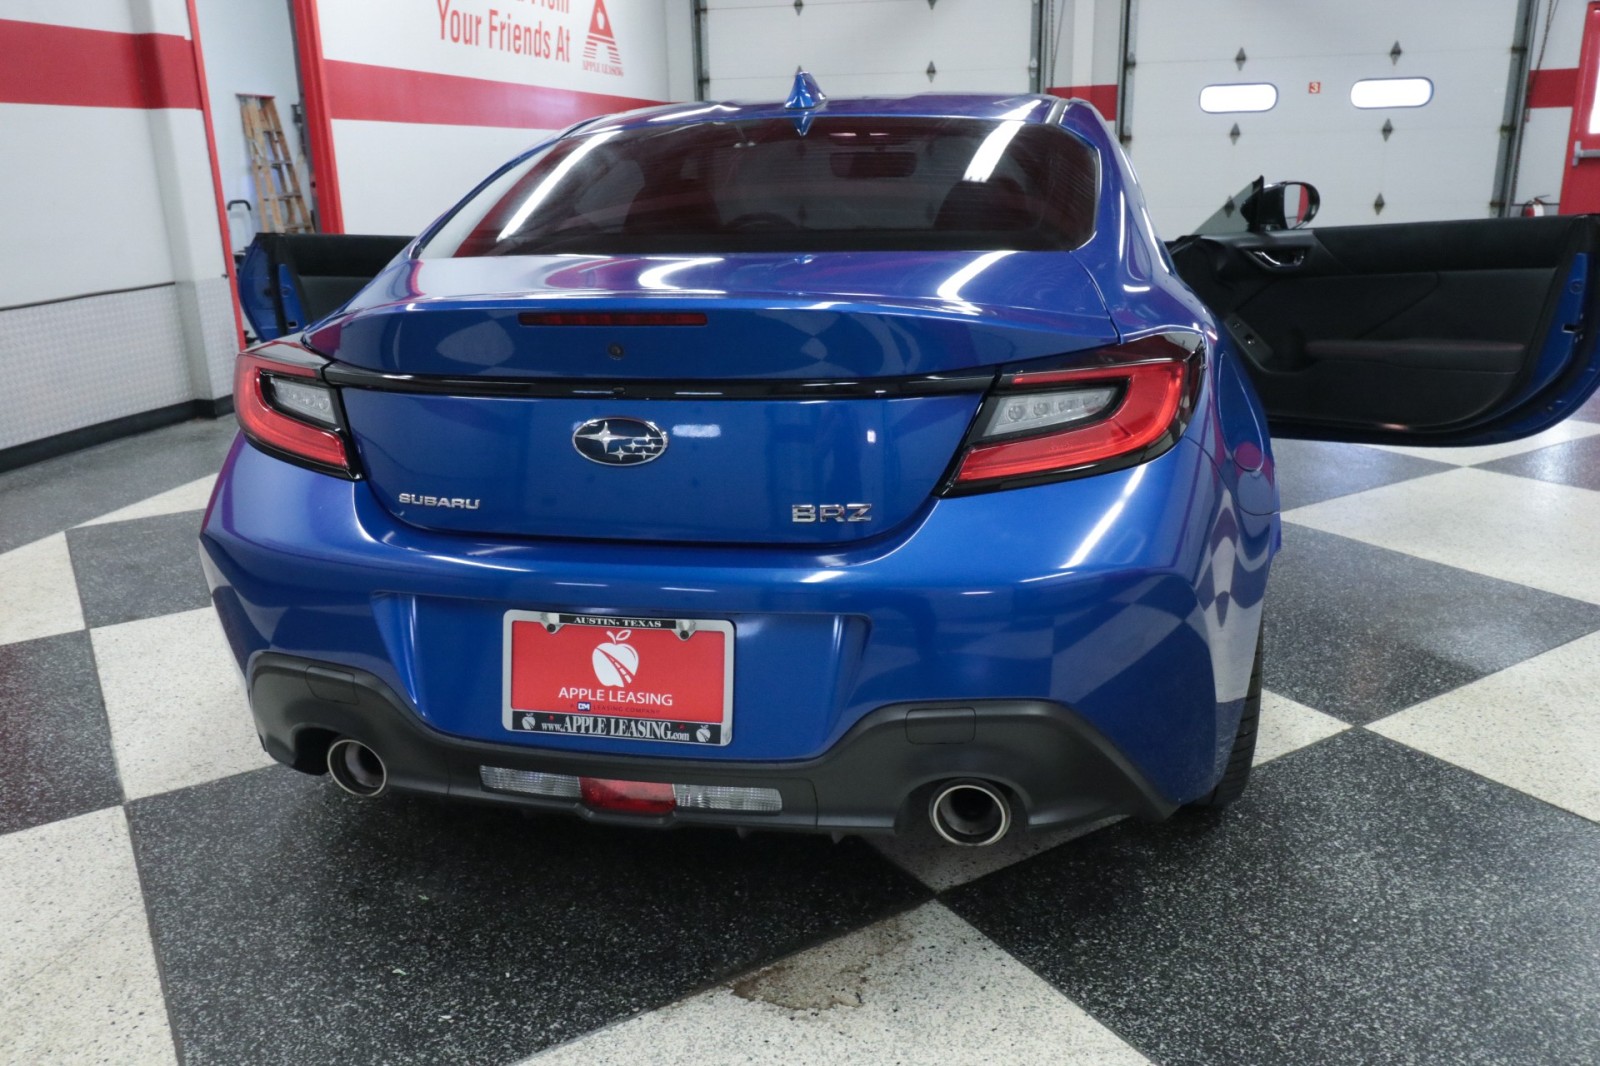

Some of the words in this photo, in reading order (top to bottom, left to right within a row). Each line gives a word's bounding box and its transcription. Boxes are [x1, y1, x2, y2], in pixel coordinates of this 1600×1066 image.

[437, 0, 482, 46] Your
[488, 9, 551, 60] Friends
[555, 25, 571, 62] At
[398, 493, 480, 510] SUBARU
[792, 504, 872, 523] BRZ
[622, 619, 662, 628] TEXAS
[558, 686, 605, 701] APPLE
[608, 690, 673, 706] LEASING
